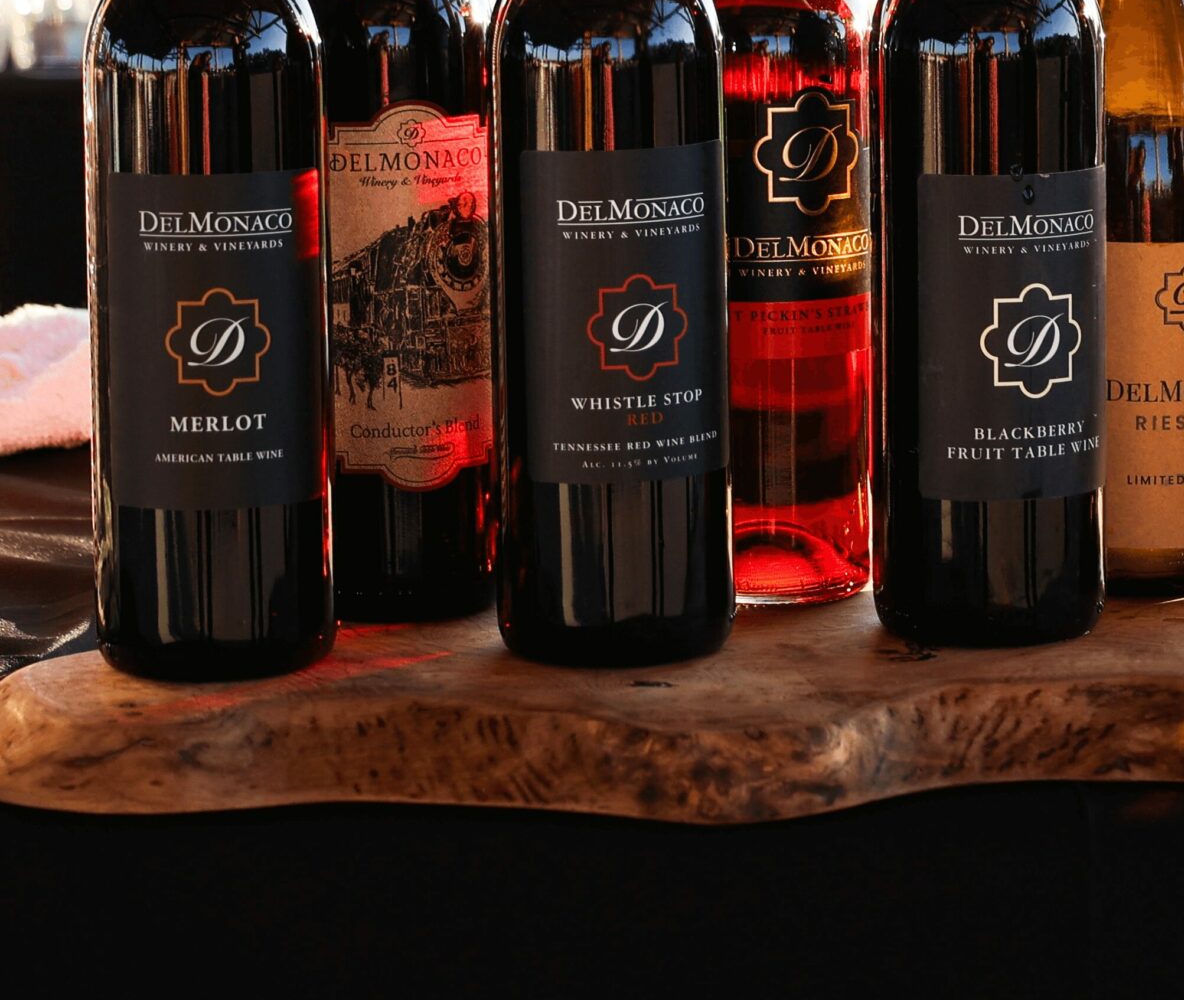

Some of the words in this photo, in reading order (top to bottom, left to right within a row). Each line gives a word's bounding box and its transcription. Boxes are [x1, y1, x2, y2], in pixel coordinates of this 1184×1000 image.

[329, 147, 482, 172] DELMONACO
[778, 123, 843, 182] D
[359, 176, 398, 190] Winery
[401, 177, 411, 185] &
[556, 196, 705, 222] DELMONACO
[139, 210, 293, 234] DELMONACO
[562, 231, 615, 241] WINERY
[620, 231, 629, 239] &
[635, 222, 701, 238] VINEYARDS
[958, 212, 1095, 237] DELMONACO
[143, 242, 193, 252] WINERY
[198, 243, 208, 252] &
[214, 239, 284, 251] VINEYARDS
[734, 233, 869, 259] DELMONACO
[963, 246, 1015, 255] WINERY
[1020, 246, 1028, 254] &
[1034, 240, 1090, 253] VINEYARDS
[739, 268, 793, 277] WINERY
[798, 268, 806, 276] &
[812, 261, 866, 276] VINEYARDS
[609, 300, 669, 353] D
[187, 316, 250, 367] D
[1003, 313, 1065, 368] D
[571, 393, 657, 411] WHISTLE
[663, 388, 703, 406] STOP
[170, 413, 267, 433] MERLOT
[350, 420, 442, 439] Conductor's
[445, 413, 480, 434] Blend
[627, 412, 664, 426] RED
[974, 420, 1085, 441] BLACKBERRY
[553, 442, 621, 452] TENNESSEE
[626, 441, 651, 450] RED
[656, 436, 685, 448] WINE
[689, 430, 718, 444] BLEND
[947, 446, 1005, 461] FRUIT
[1011, 443, 1066, 460] TABLE
[1070, 435, 1100, 454] WINE
[155, 453, 214, 464] AMERICAN
[218, 452, 253, 463] TABLE
[256, 449, 284, 460] WINE
[663, 453, 698, 464] VOLUME
